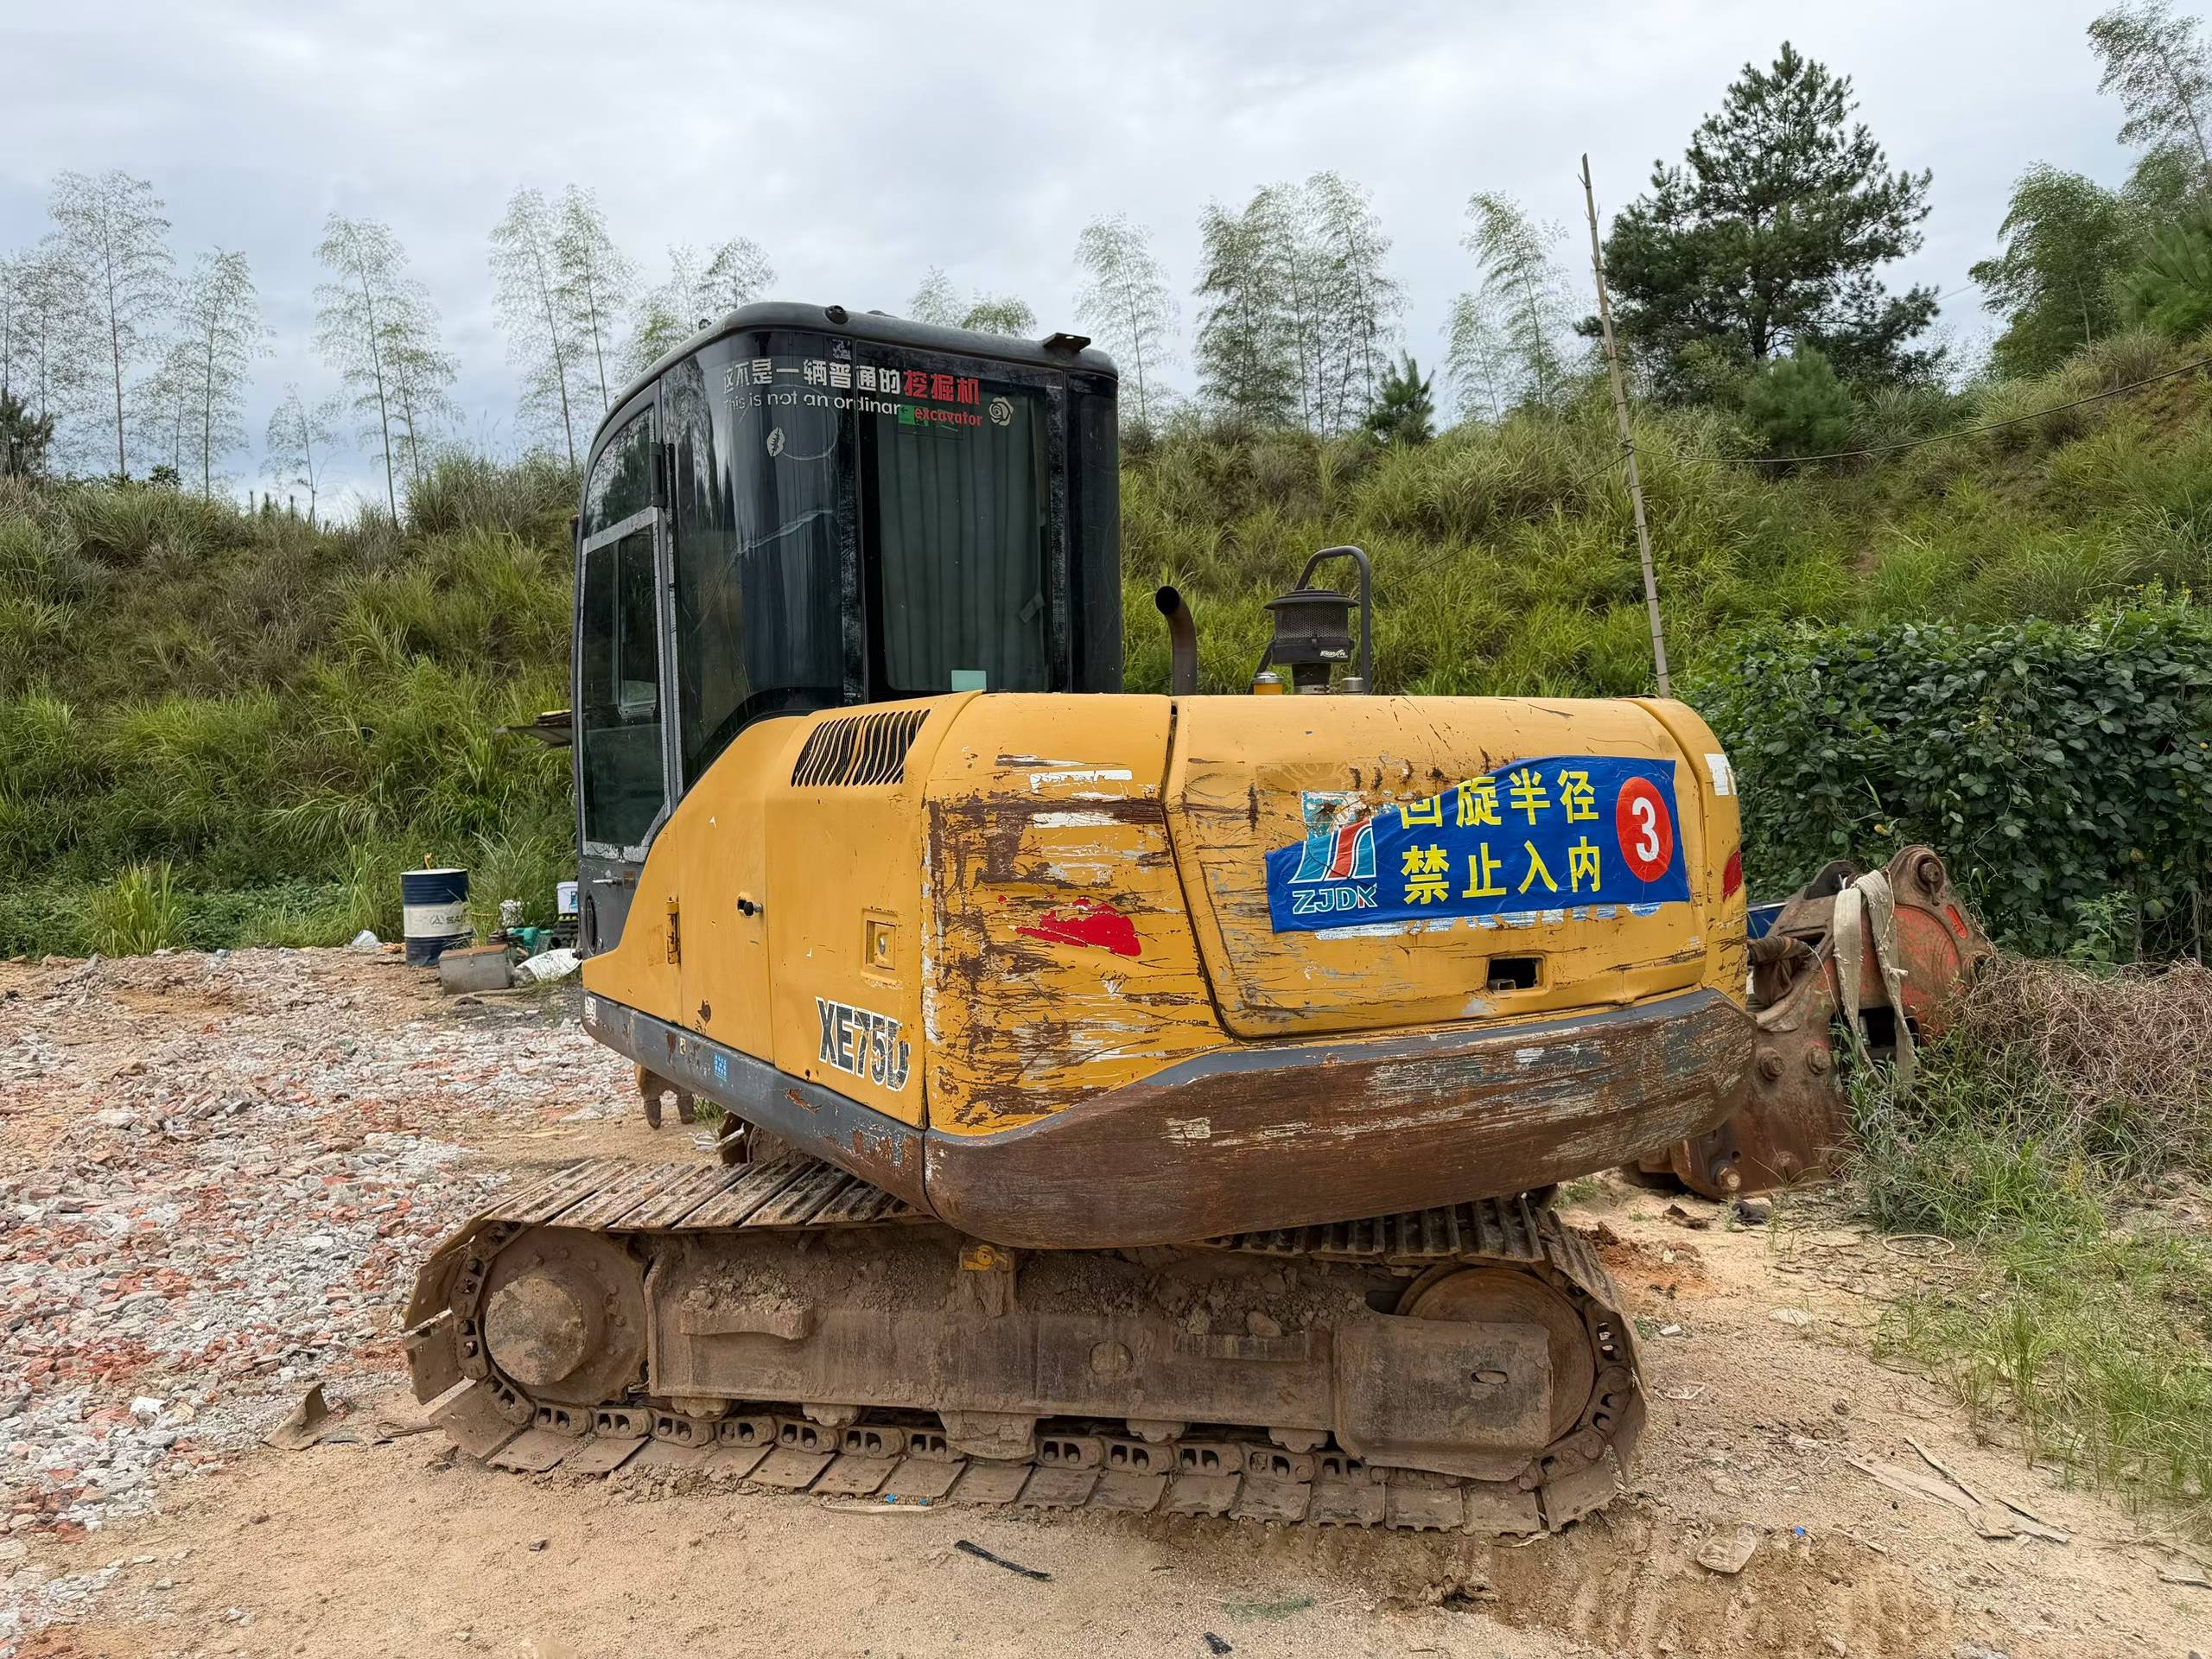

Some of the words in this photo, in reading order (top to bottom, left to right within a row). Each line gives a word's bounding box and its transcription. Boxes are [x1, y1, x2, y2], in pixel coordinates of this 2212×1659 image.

[723, 357, 981, 405] 这不是一辆普通的挖掘机
[749, 392, 762, 407] is
[767, 390, 797, 405] not
[804, 393, 829, 408] an
[914, 406, 982, 427] excavator
[1631, 796, 1660, 862] 3
[1401, 836, 1601, 905] 禁止入内
[1292, 882, 1379, 915] ZJDK
